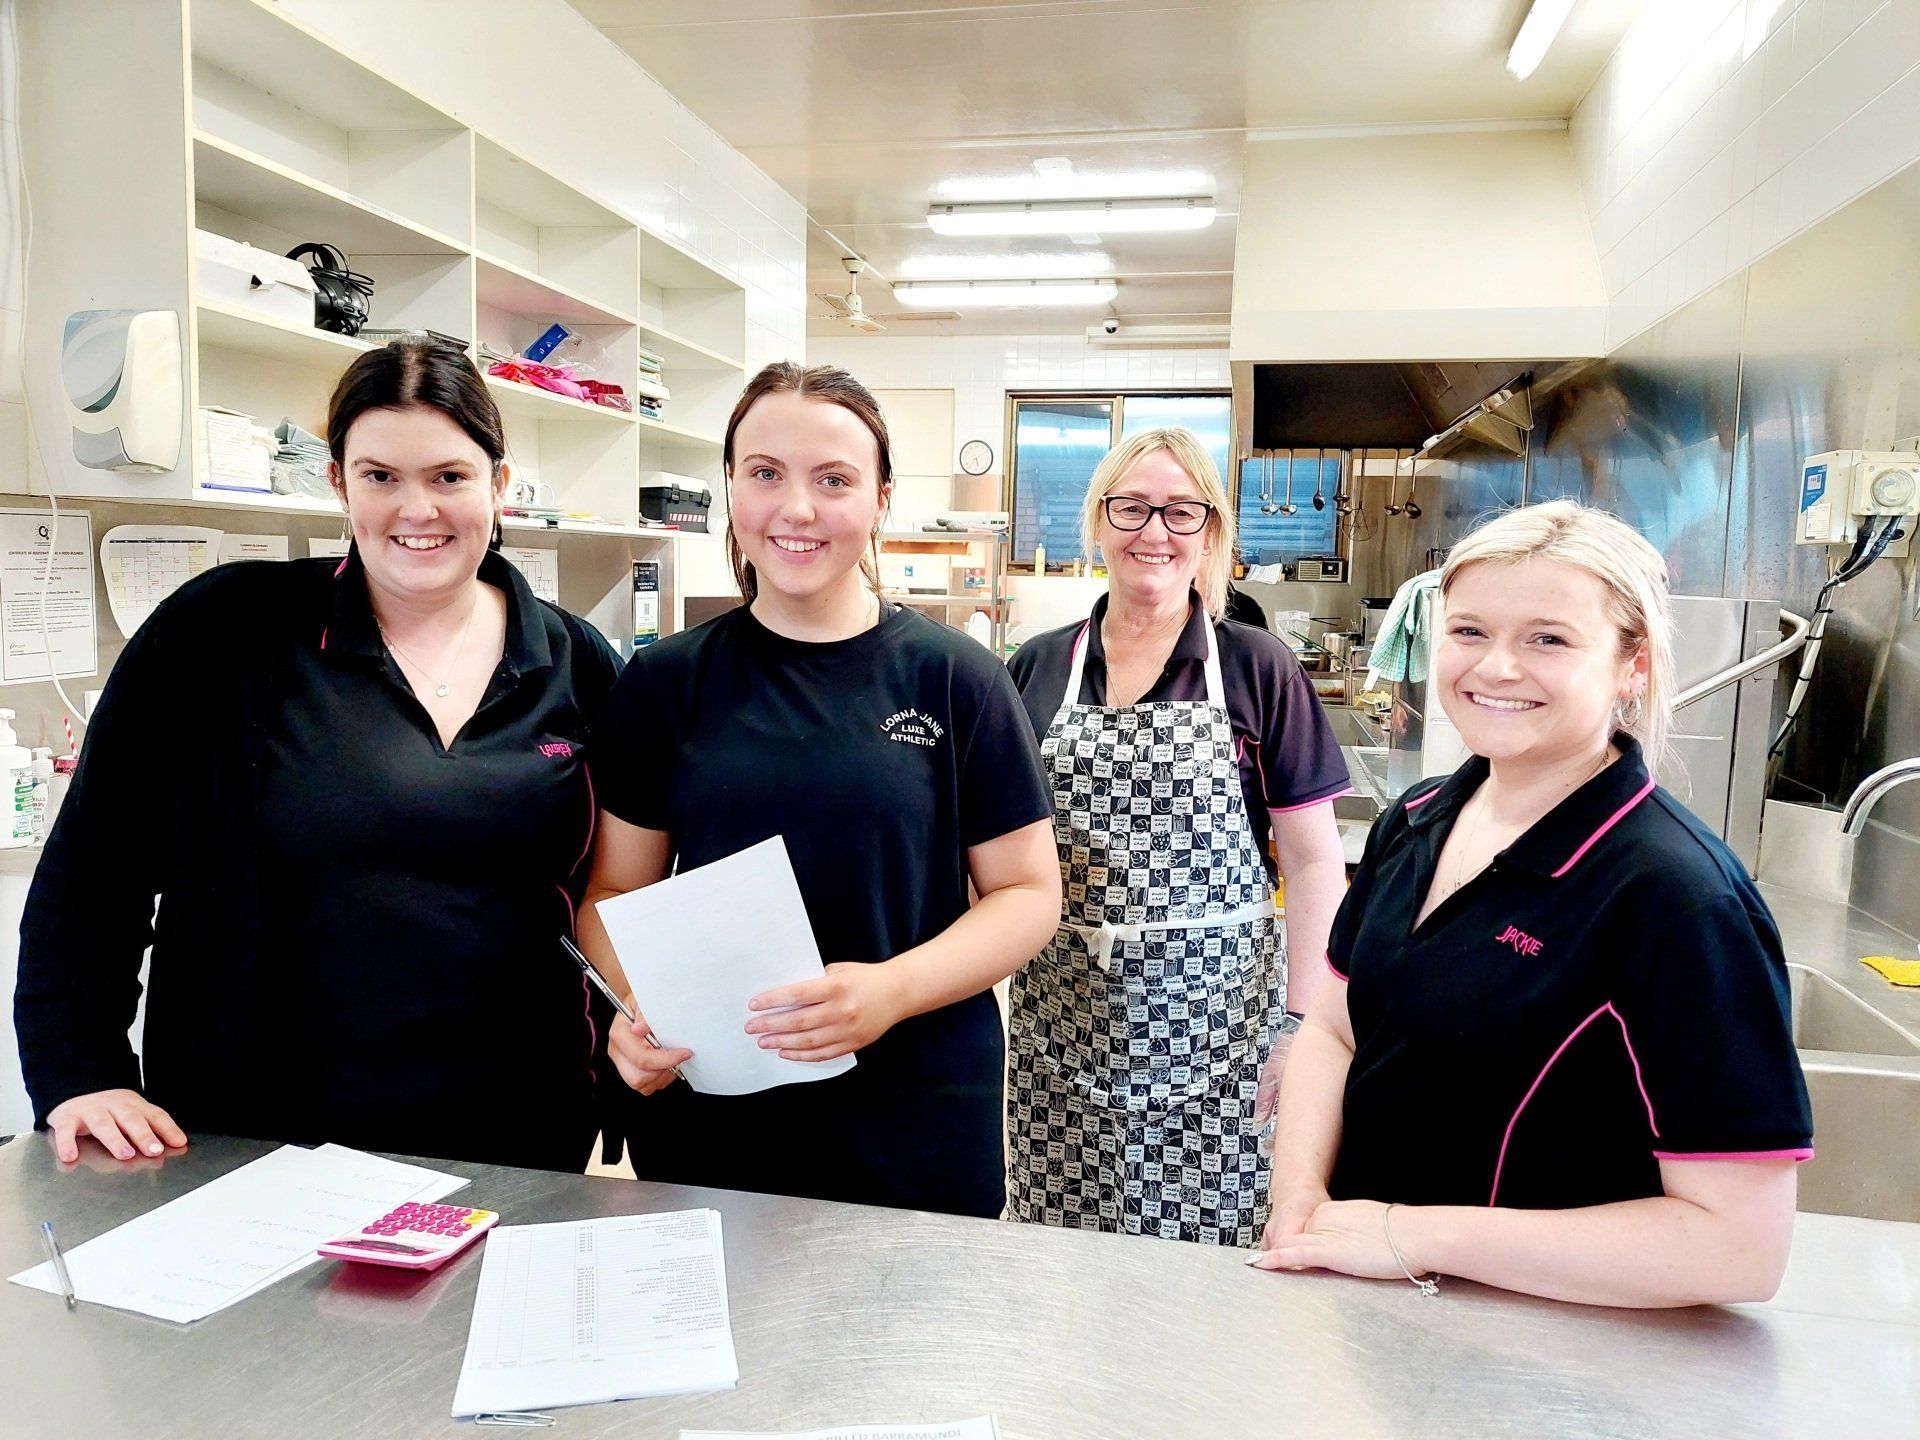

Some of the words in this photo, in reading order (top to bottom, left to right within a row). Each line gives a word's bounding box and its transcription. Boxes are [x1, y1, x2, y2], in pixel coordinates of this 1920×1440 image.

[880, 708, 918, 732] LORNA
[919, 714, 944, 738] JANE
[902, 725, 925, 735] LUXE
[890, 733, 936, 746] ATHLETIC
[1495, 925, 1544, 956] JACKIE
[872, 1429, 961, 1440] BARRAMUNDI
